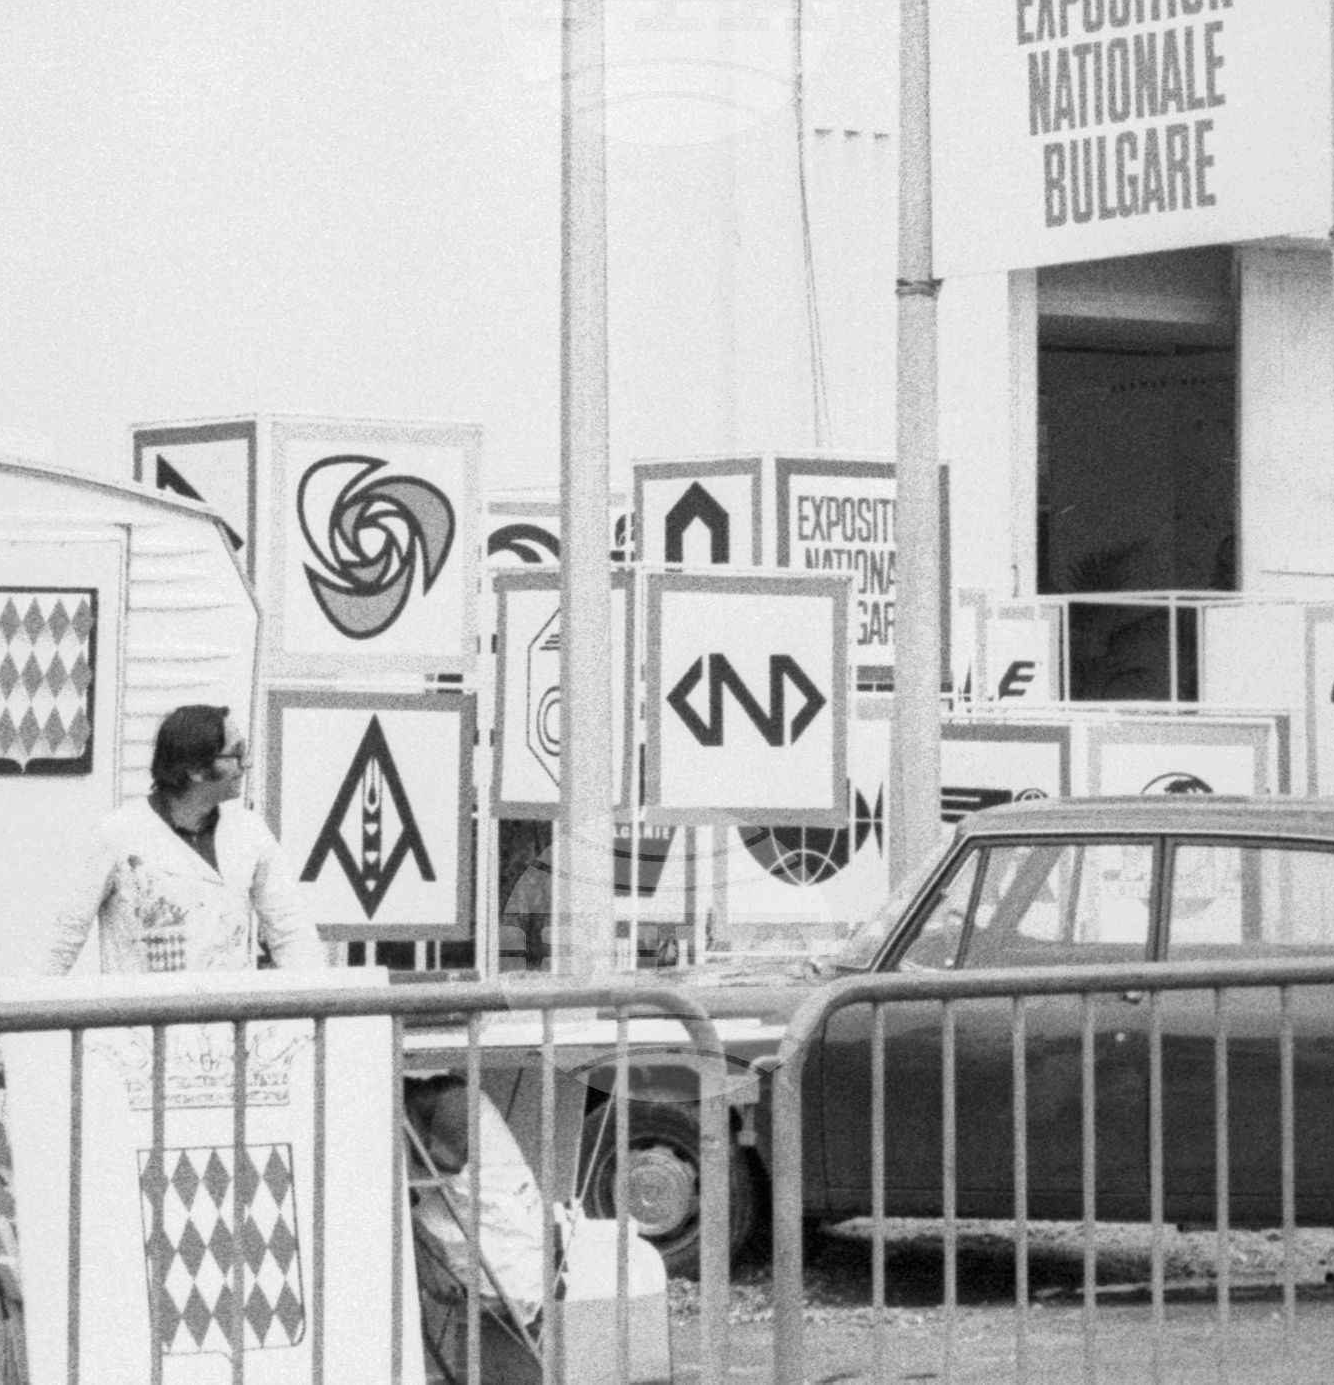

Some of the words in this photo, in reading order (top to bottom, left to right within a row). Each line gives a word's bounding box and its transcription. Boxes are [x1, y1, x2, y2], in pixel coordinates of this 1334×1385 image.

[1027, 20, 1226, 136] NATIONALE
[1042, 118, 1217, 228] BULGARE
[797, 495, 896, 543] EXPOSITI
